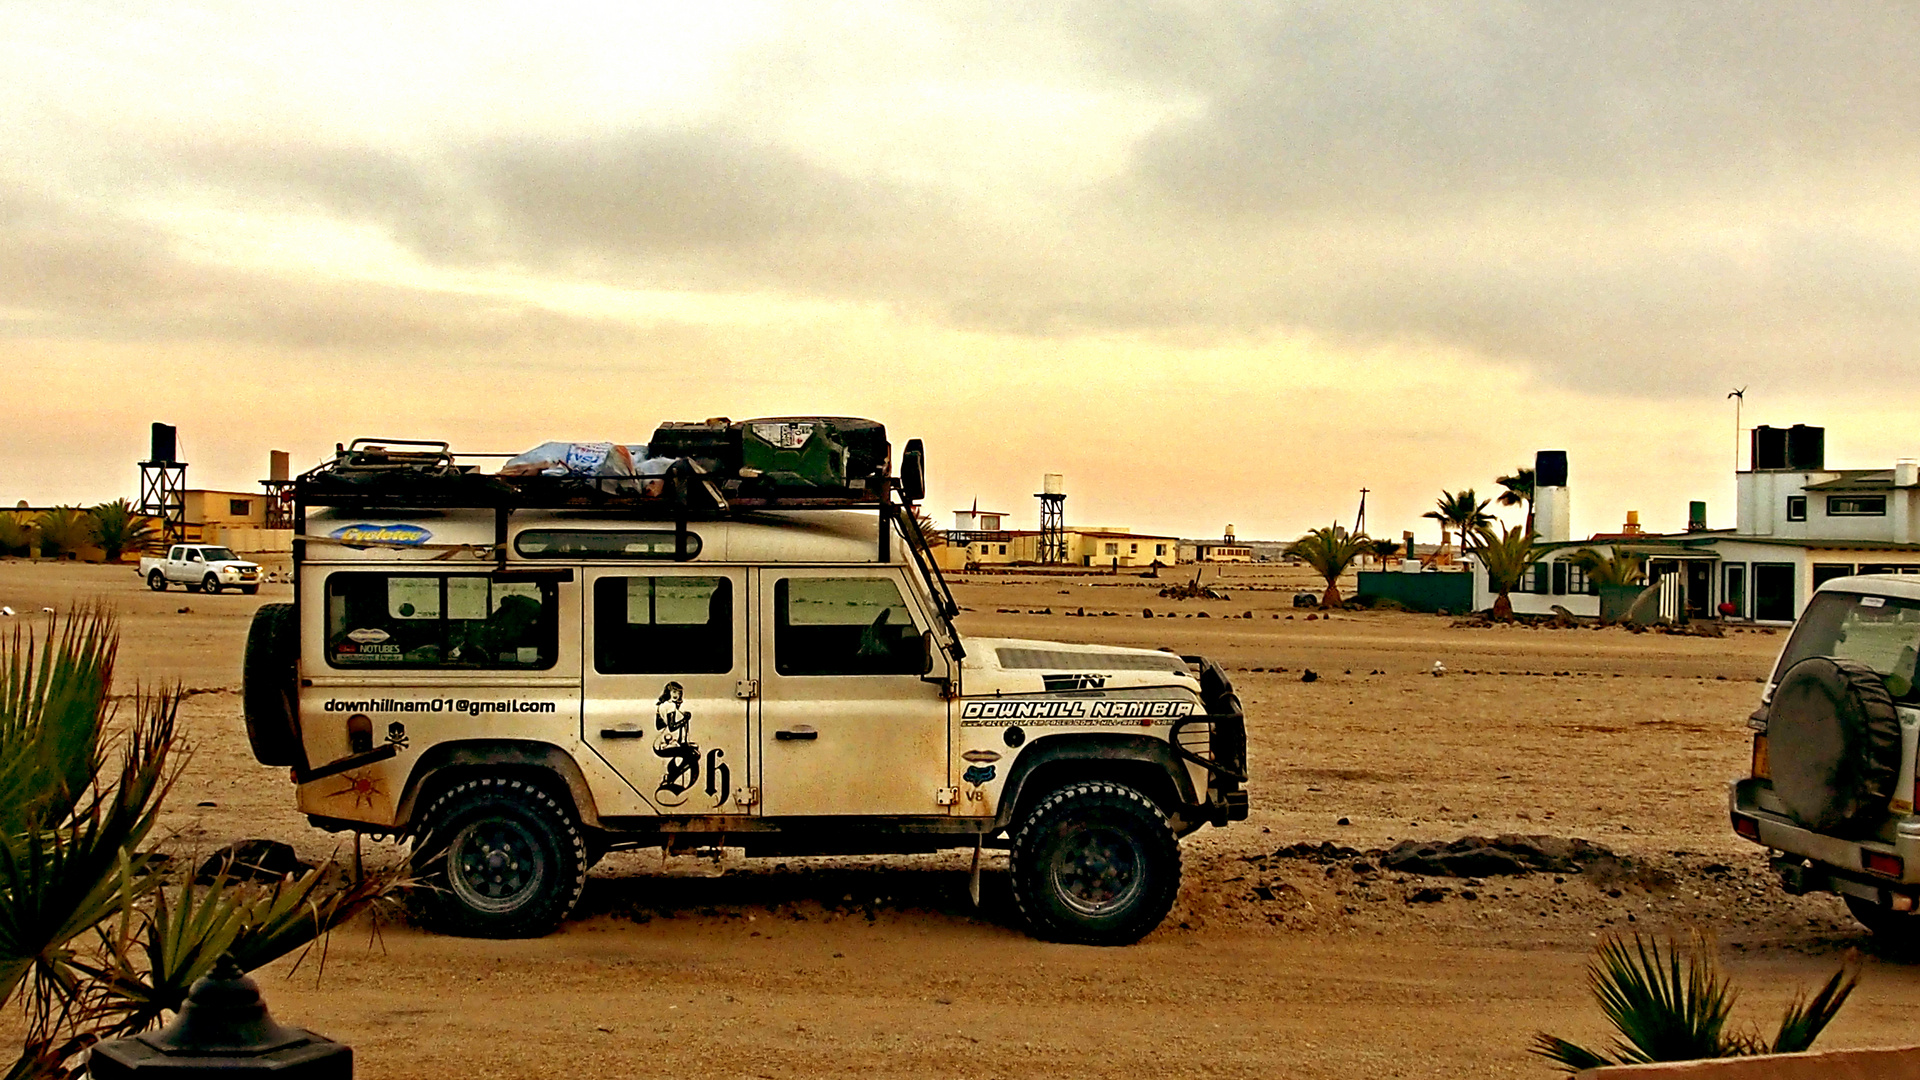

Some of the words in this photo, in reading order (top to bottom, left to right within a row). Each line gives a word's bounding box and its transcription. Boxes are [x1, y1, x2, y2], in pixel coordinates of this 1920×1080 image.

[360, 644, 400, 653] NOTUBES
[323, 698, 556, 716] downhillnam01@gmail.com
[961, 702, 1084, 719] DOWNHILL
[1090, 702, 1195, 718] NAMIBIA
[965, 791, 984, 801] V8
